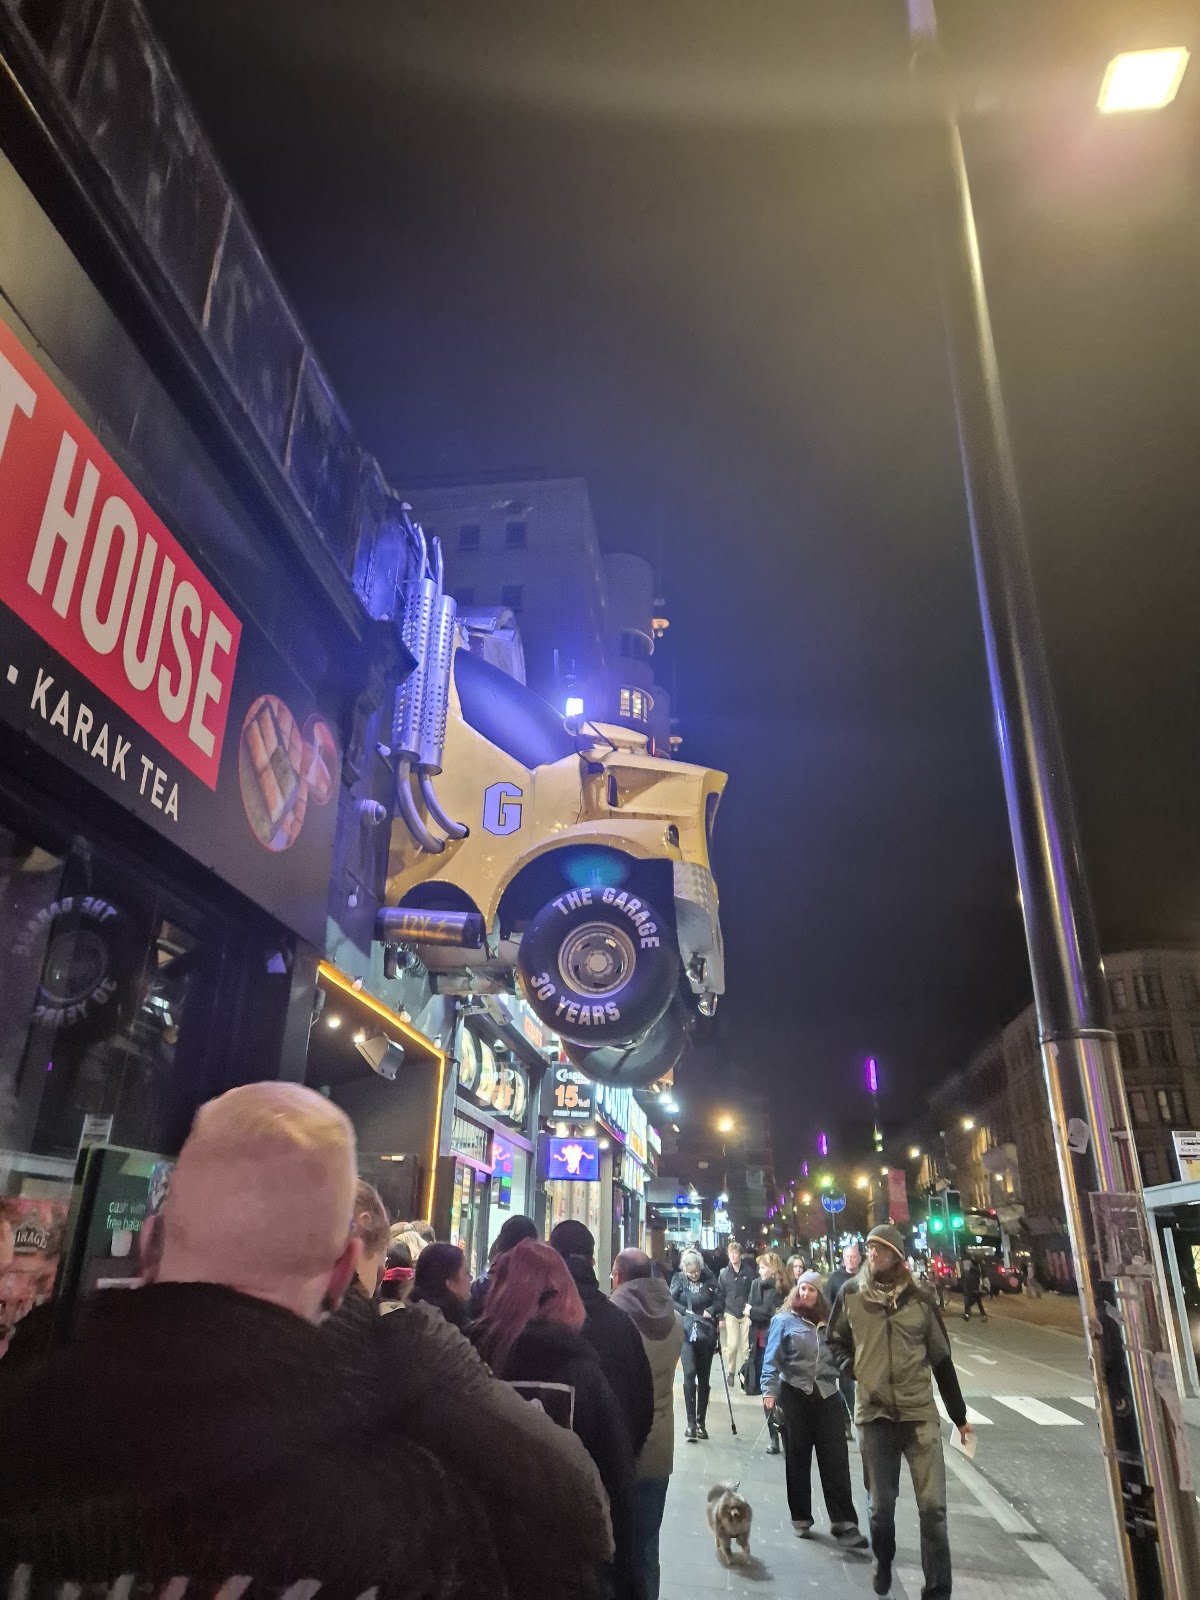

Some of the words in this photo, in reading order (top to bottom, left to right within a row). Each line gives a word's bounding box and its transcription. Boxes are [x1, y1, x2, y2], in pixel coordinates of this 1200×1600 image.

[27, 430, 232, 758] HOUSE
[30, 667, 132, 781] KARAK
[139, 754, 178, 822] TEA
[483, 782, 523, 835] G
[552, 887, 593, 916] THE
[602, 887, 660, 949] GARAGE
[530, 972, 556, 1001] 30
[555, 995, 620, 1026] YEARS
[554, 1084, 578, 1108] 15
